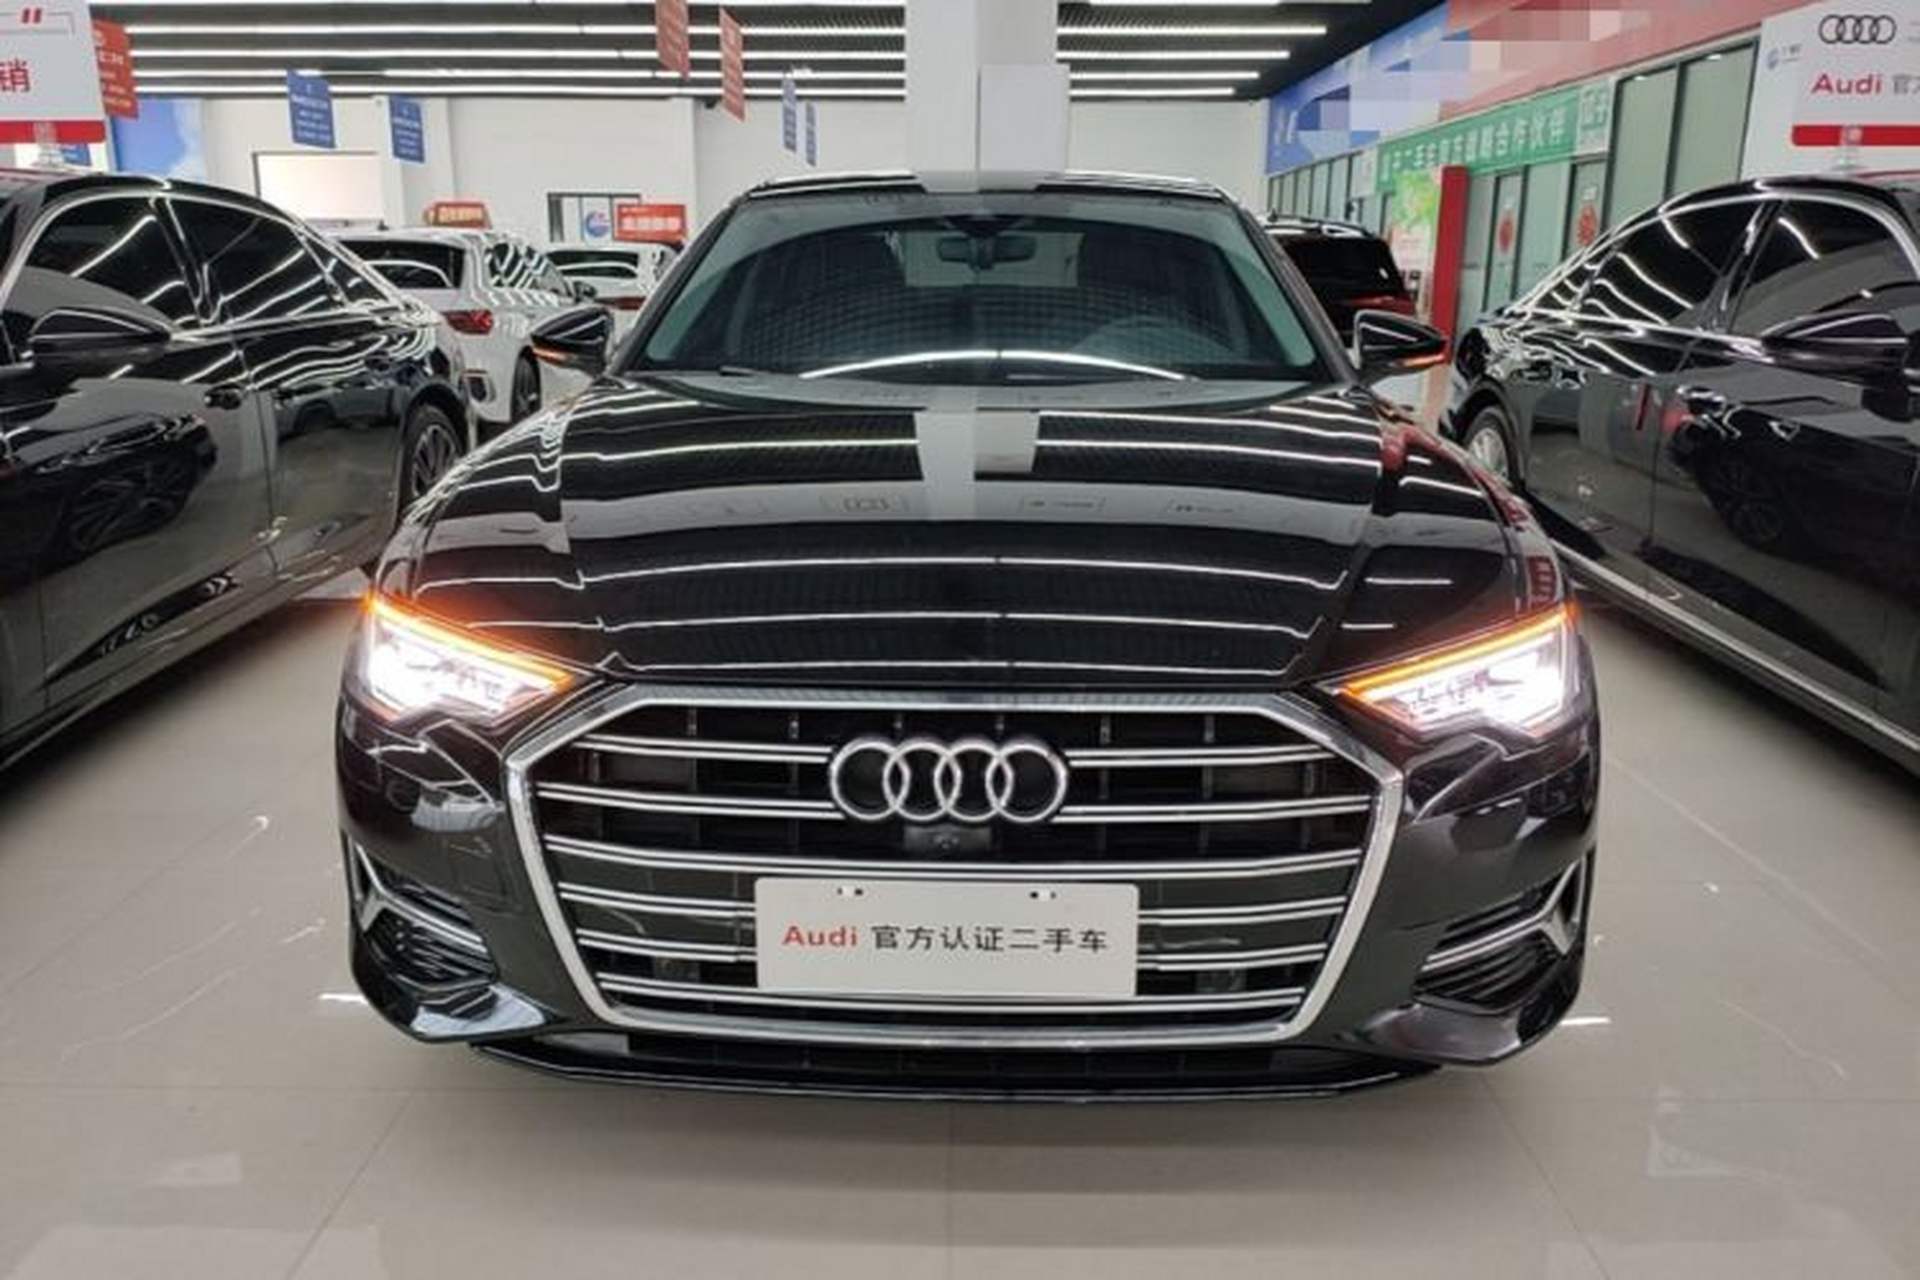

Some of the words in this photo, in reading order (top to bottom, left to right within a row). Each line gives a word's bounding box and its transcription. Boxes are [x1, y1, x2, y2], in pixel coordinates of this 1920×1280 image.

[0, 57, 30, 92] 销
[1811, 73, 1882, 94] Audi
[781, 925, 858, 946] Audi
[871, 925, 1107, 952] 官方认证二手车
